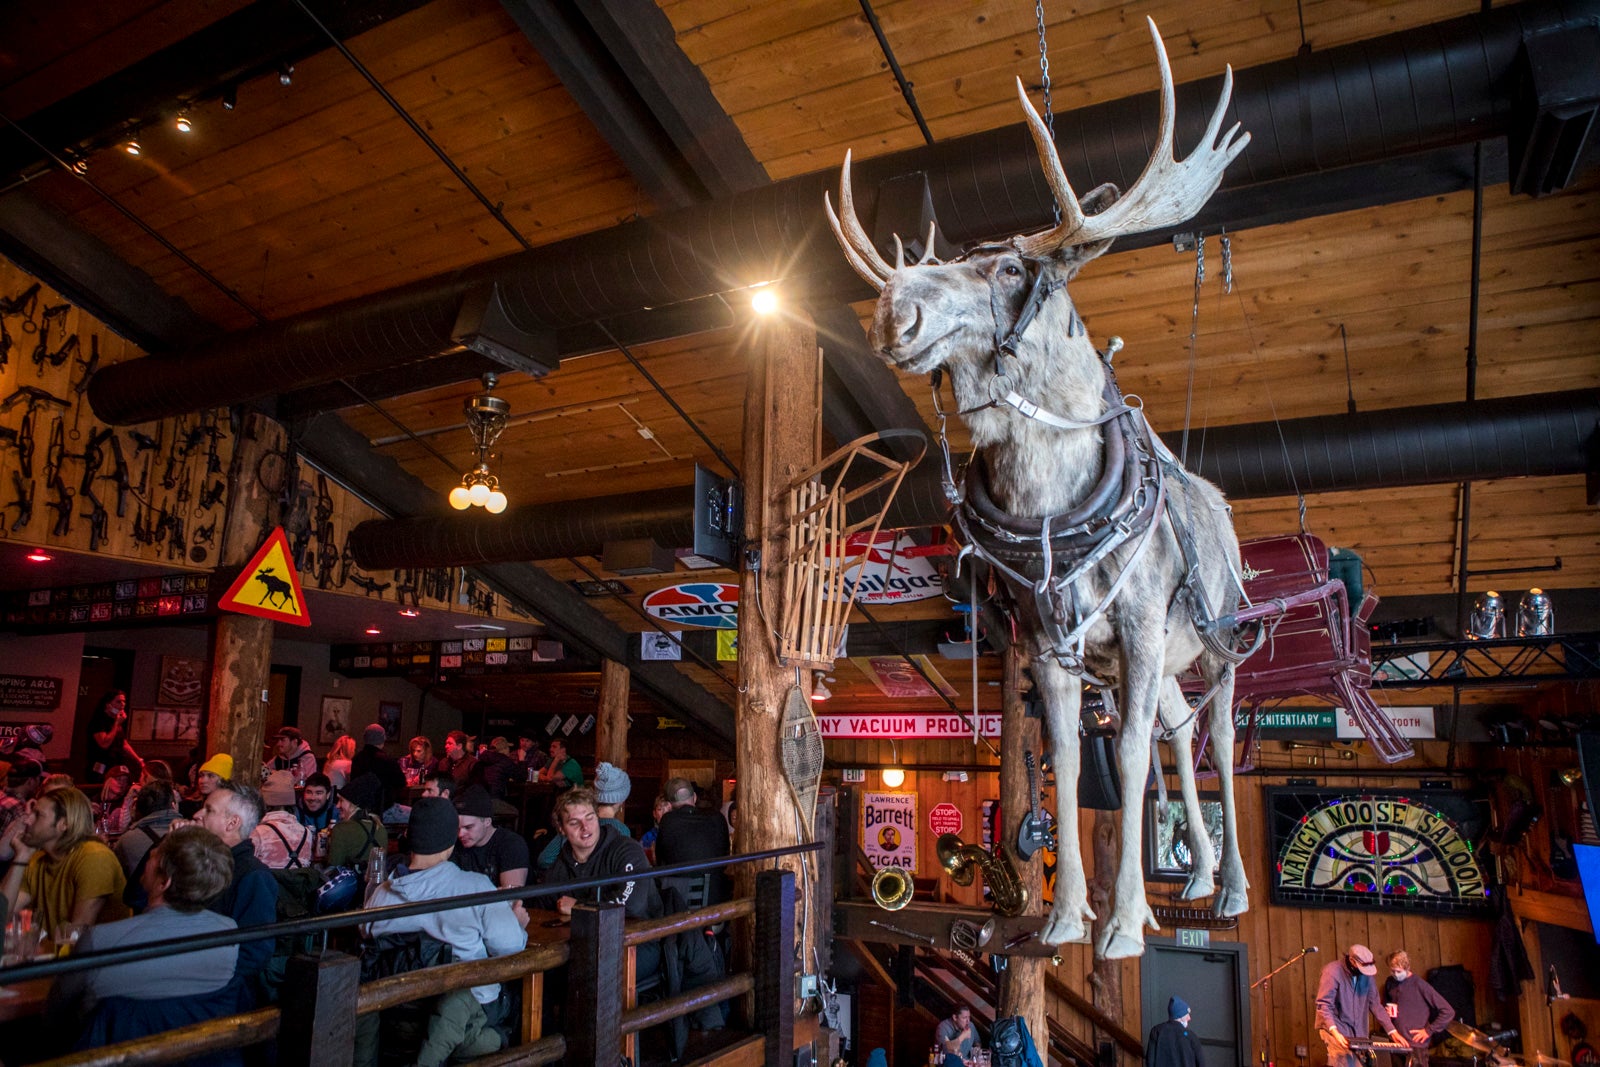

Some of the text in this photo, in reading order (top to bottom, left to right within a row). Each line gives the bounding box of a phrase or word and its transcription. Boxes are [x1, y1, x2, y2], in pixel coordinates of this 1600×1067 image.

[825, 574, 942, 594] bilgas
[659, 603, 738, 617] AMO
[30, 680, 55, 689] AREA
[811, 719, 841, 733] ONY
[850, 719, 916, 732] VACUUM
[1255, 714, 1319, 726] PENITENTIARY
[1391, 718, 1420, 727] TOOTH
[870, 795, 910, 804] LAWRENCE
[865, 805, 914, 830] Barrett
[1282, 803, 1485, 898] MANGY MOOSE SALOON
[868, 854, 912, 868] CIGAR
[1181, 930, 1204, 947] EXIT
